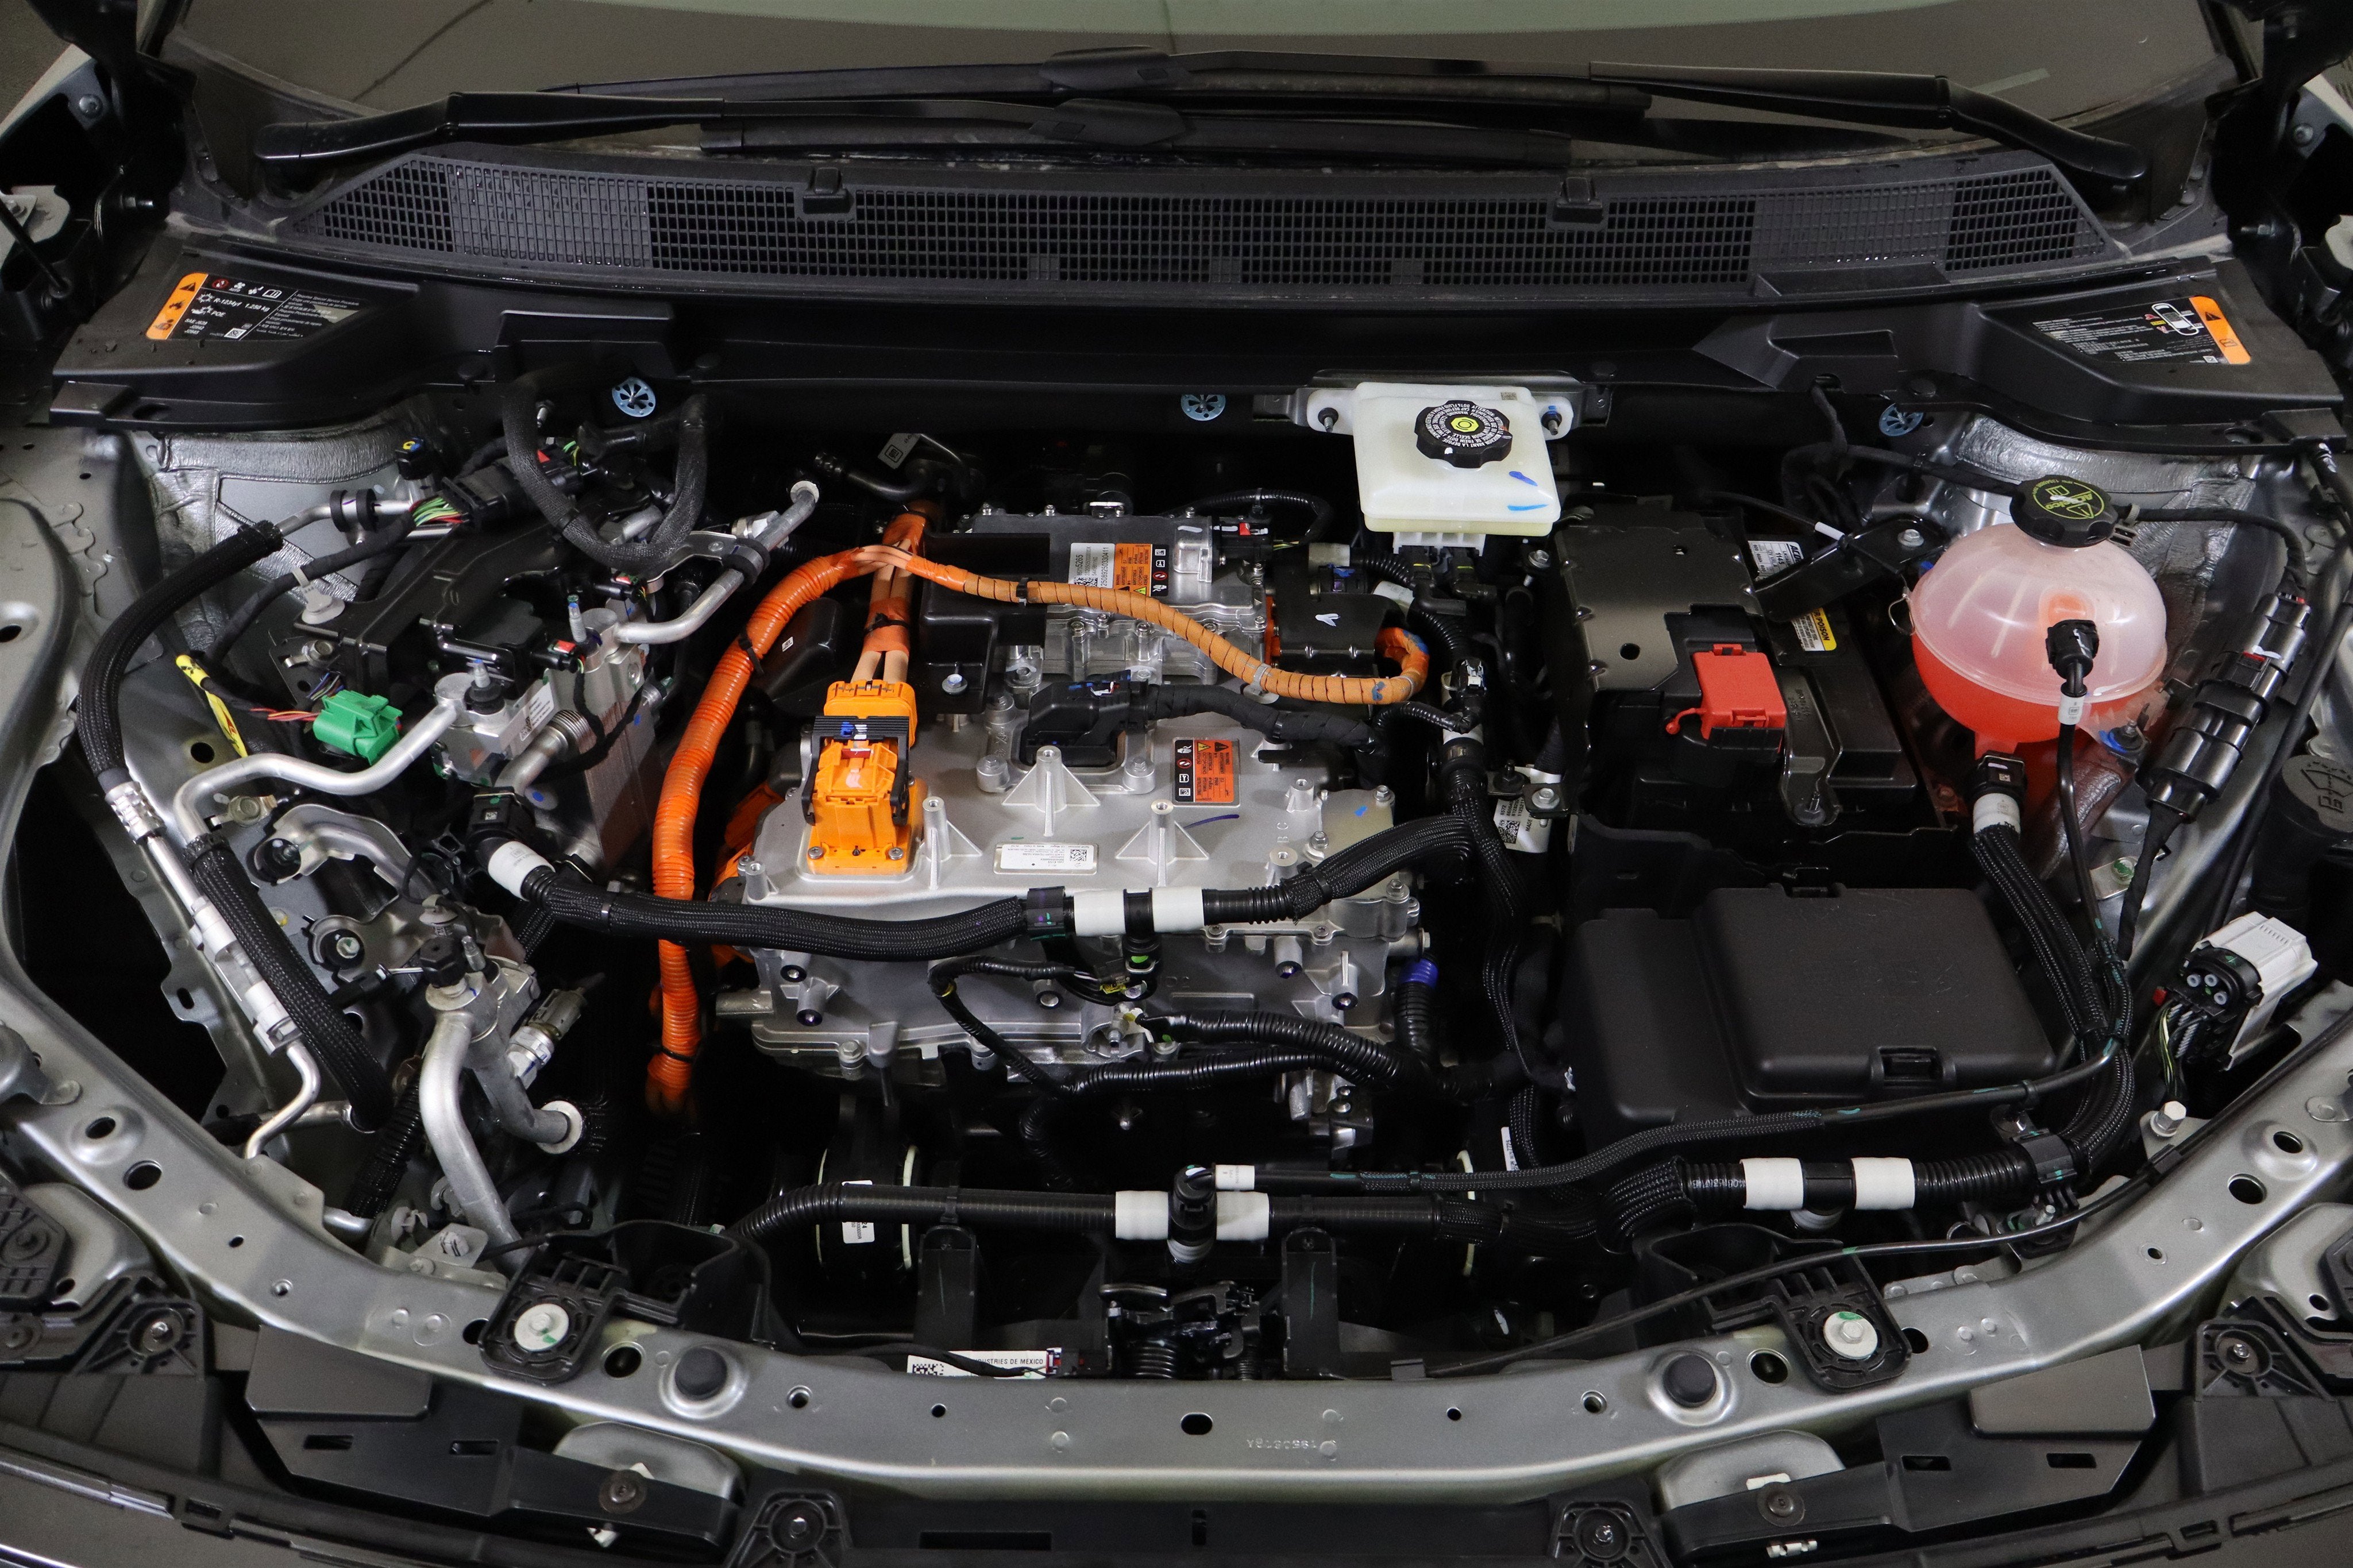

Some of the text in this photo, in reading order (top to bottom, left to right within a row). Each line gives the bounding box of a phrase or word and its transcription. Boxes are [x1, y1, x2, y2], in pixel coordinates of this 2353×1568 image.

[212, 298, 242, 307] R-1234yf
[1431, 405, 1445, 414] FROM
[1436, 429, 1447, 437] ONLY
[1483, 433, 1503, 445] BOUCHON
[1775, 553, 1785, 565] 1145
